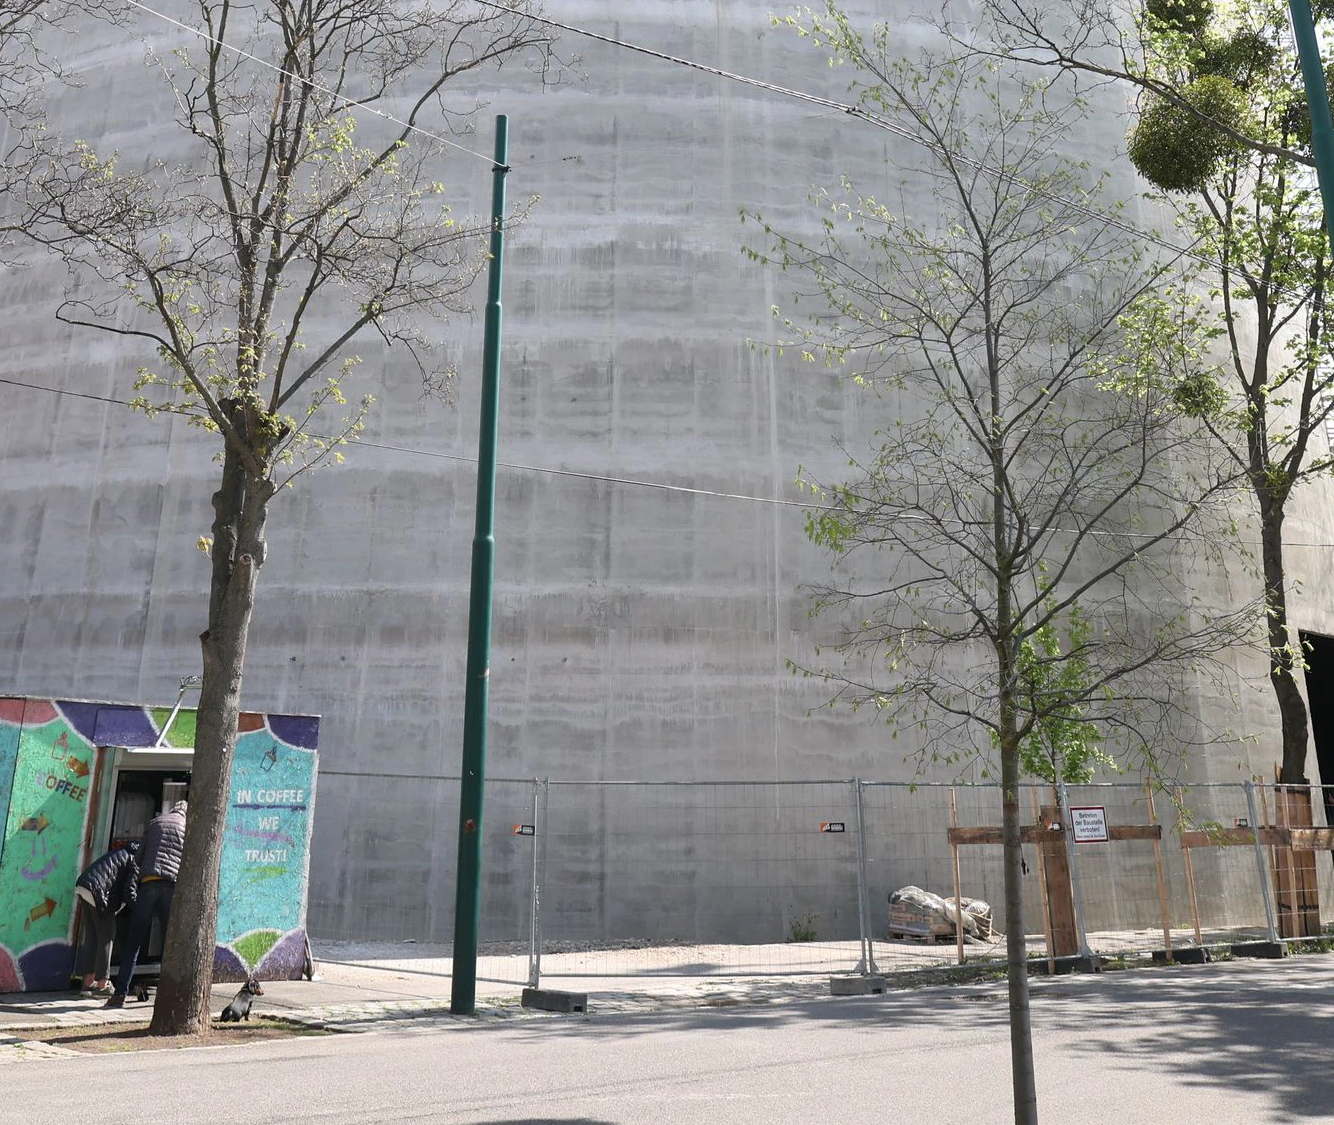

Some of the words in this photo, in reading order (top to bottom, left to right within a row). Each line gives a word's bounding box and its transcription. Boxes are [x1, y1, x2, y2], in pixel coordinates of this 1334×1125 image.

[35, 772, 87, 802] COFFEE
[237, 790, 252, 804] IN
[257, 789, 304, 803] COFFEE
[258, 816, 280, 830] WE
[245, 849, 287, 862] TRUST!
